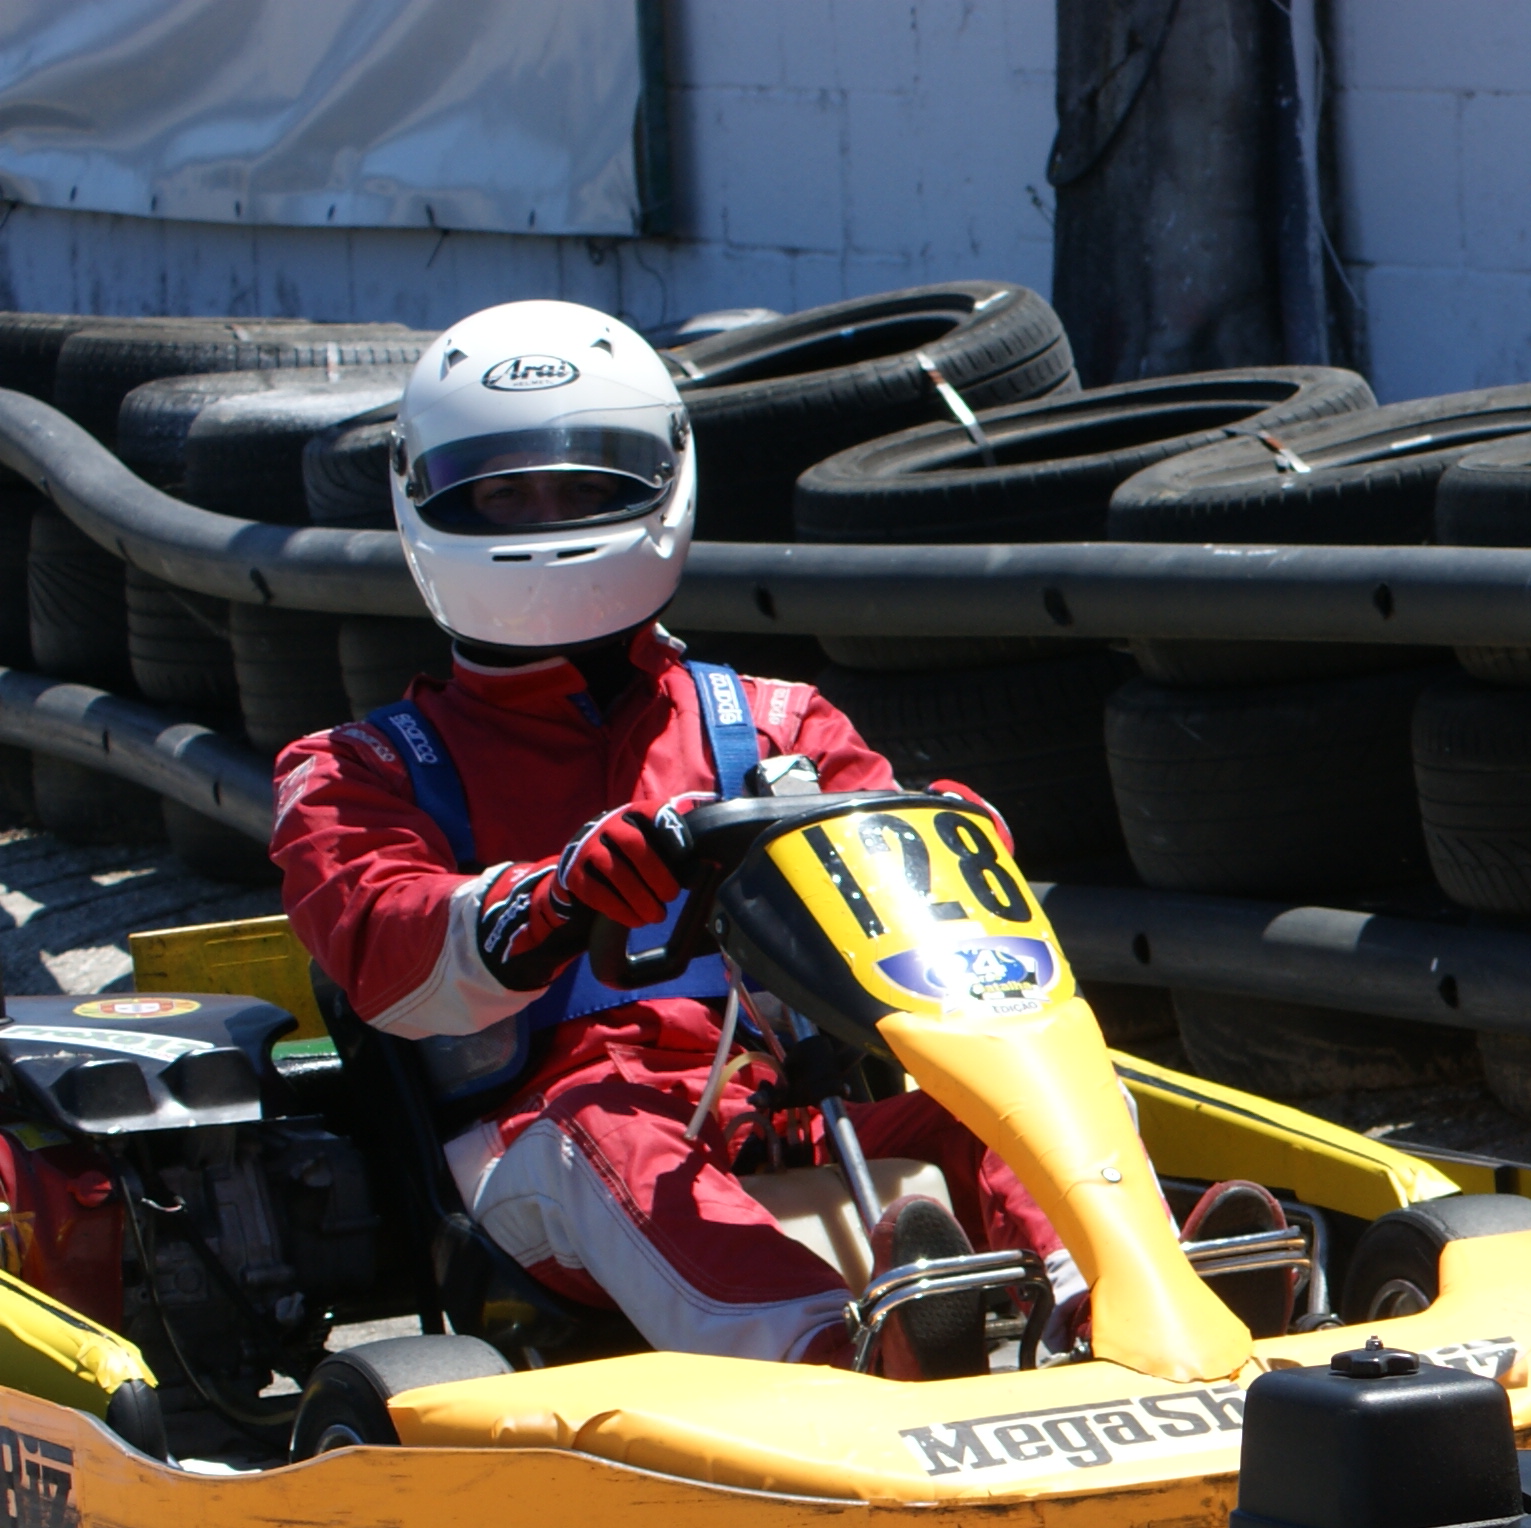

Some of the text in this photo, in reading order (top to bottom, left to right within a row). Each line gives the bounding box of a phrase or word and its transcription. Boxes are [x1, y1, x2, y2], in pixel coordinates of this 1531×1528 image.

[488, 358, 566, 386] Arai
[801, 811, 1033, 940] 128
[899, 1384, 1247, 1477] MegaSh
